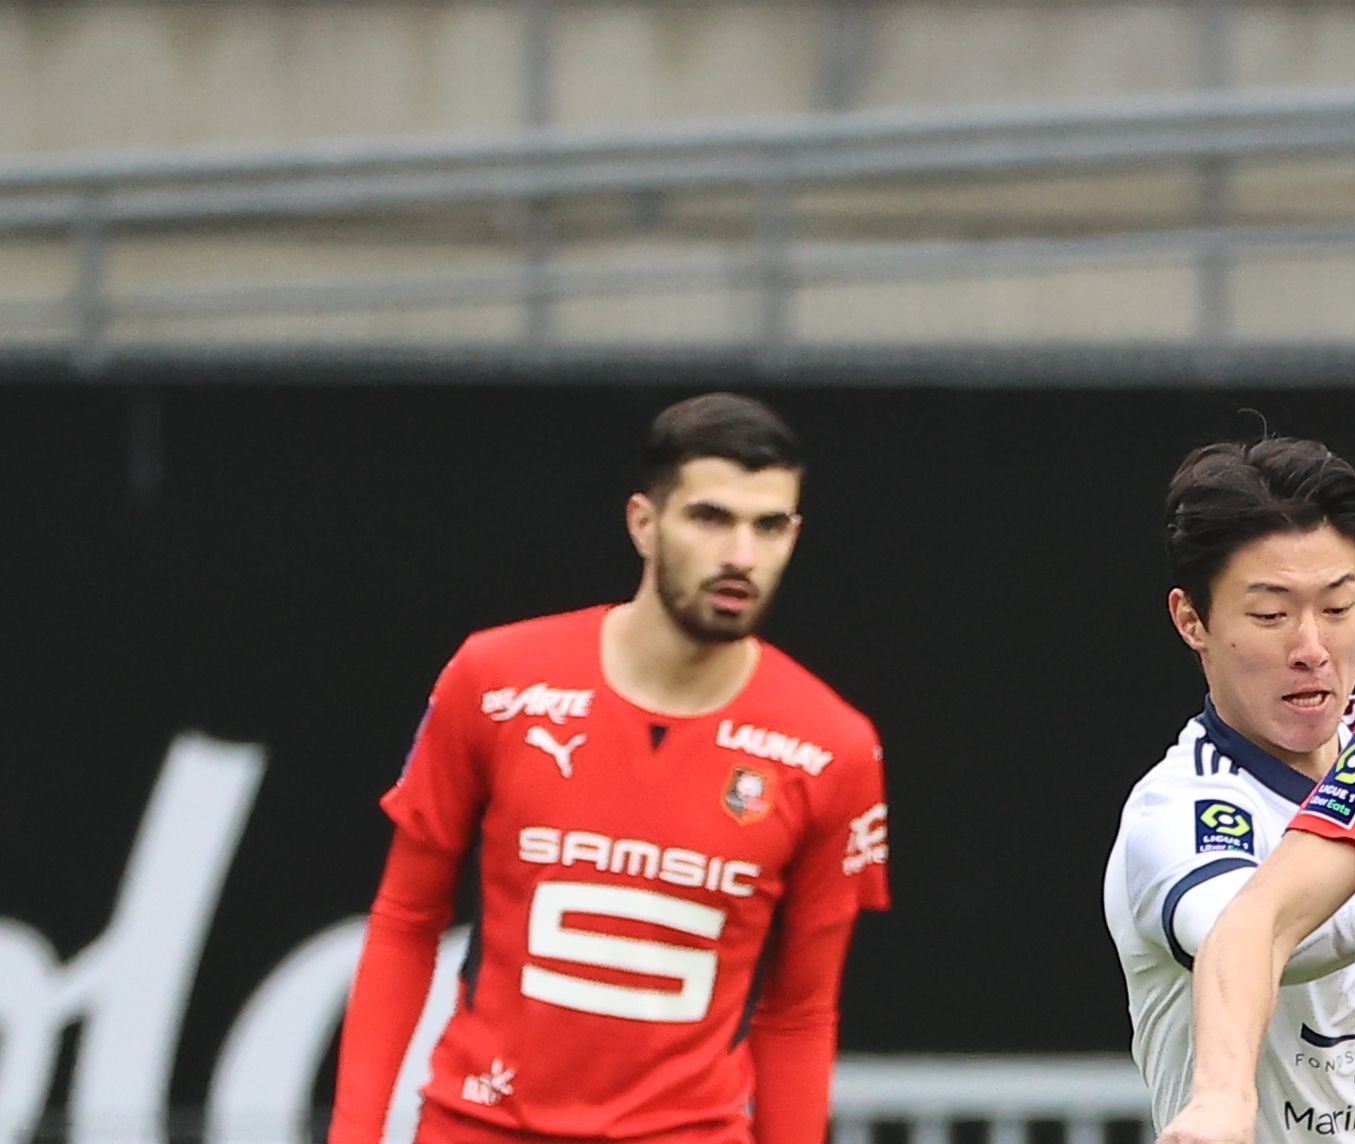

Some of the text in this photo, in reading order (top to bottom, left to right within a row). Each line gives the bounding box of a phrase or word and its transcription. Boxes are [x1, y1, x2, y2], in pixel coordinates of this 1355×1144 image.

[716, 719, 834, 777] LAUNAY
[1318, 784, 1349, 800] LIGUE
[518, 826, 761, 898] SAMSIC
